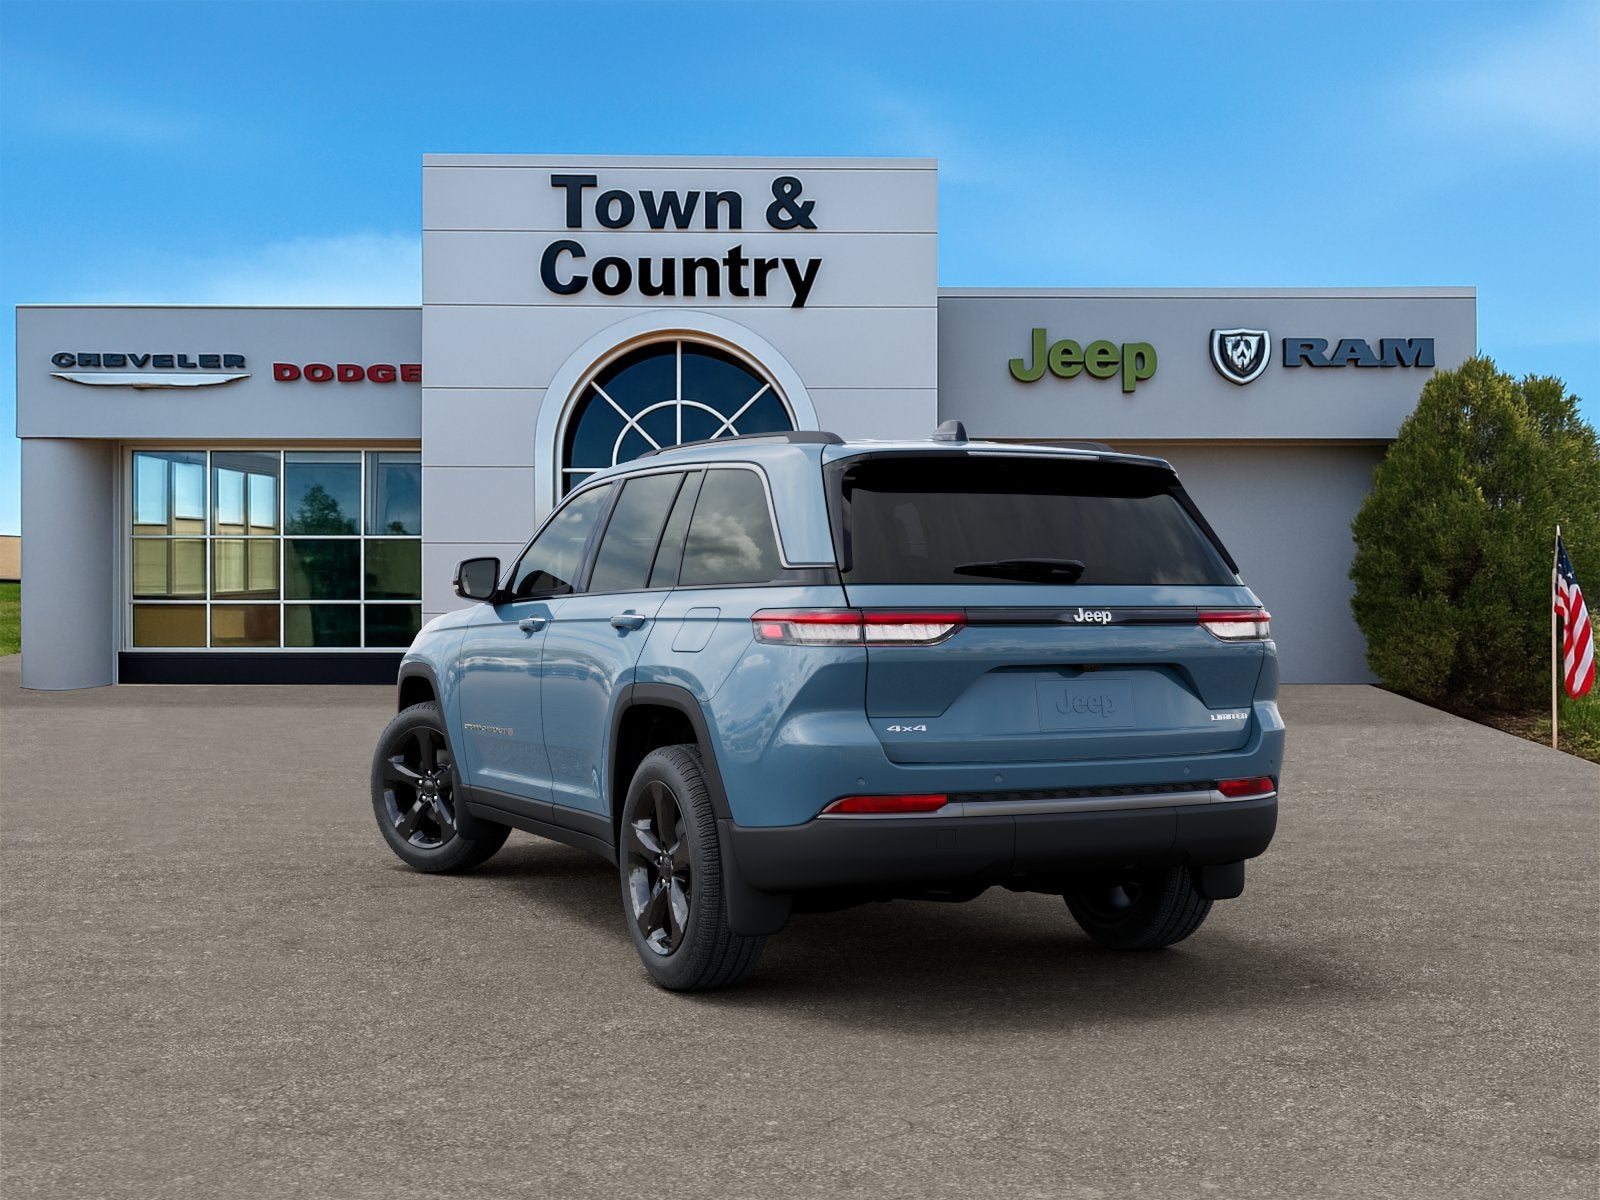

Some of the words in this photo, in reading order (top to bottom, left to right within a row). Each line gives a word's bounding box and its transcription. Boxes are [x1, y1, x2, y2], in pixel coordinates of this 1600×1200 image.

[550, 174, 743, 229] Town
[765, 176, 818, 230] &
[540, 239, 822, 308] Country
[1009, 328, 1158, 393] Jeep
[1283, 337, 1436, 368] RAM
[273, 363, 422, 384] DODGE
[1073, 608, 1112, 624] Jeep
[1056, 689, 1118, 719] Jeep
[886, 724, 927, 732] 4x4
